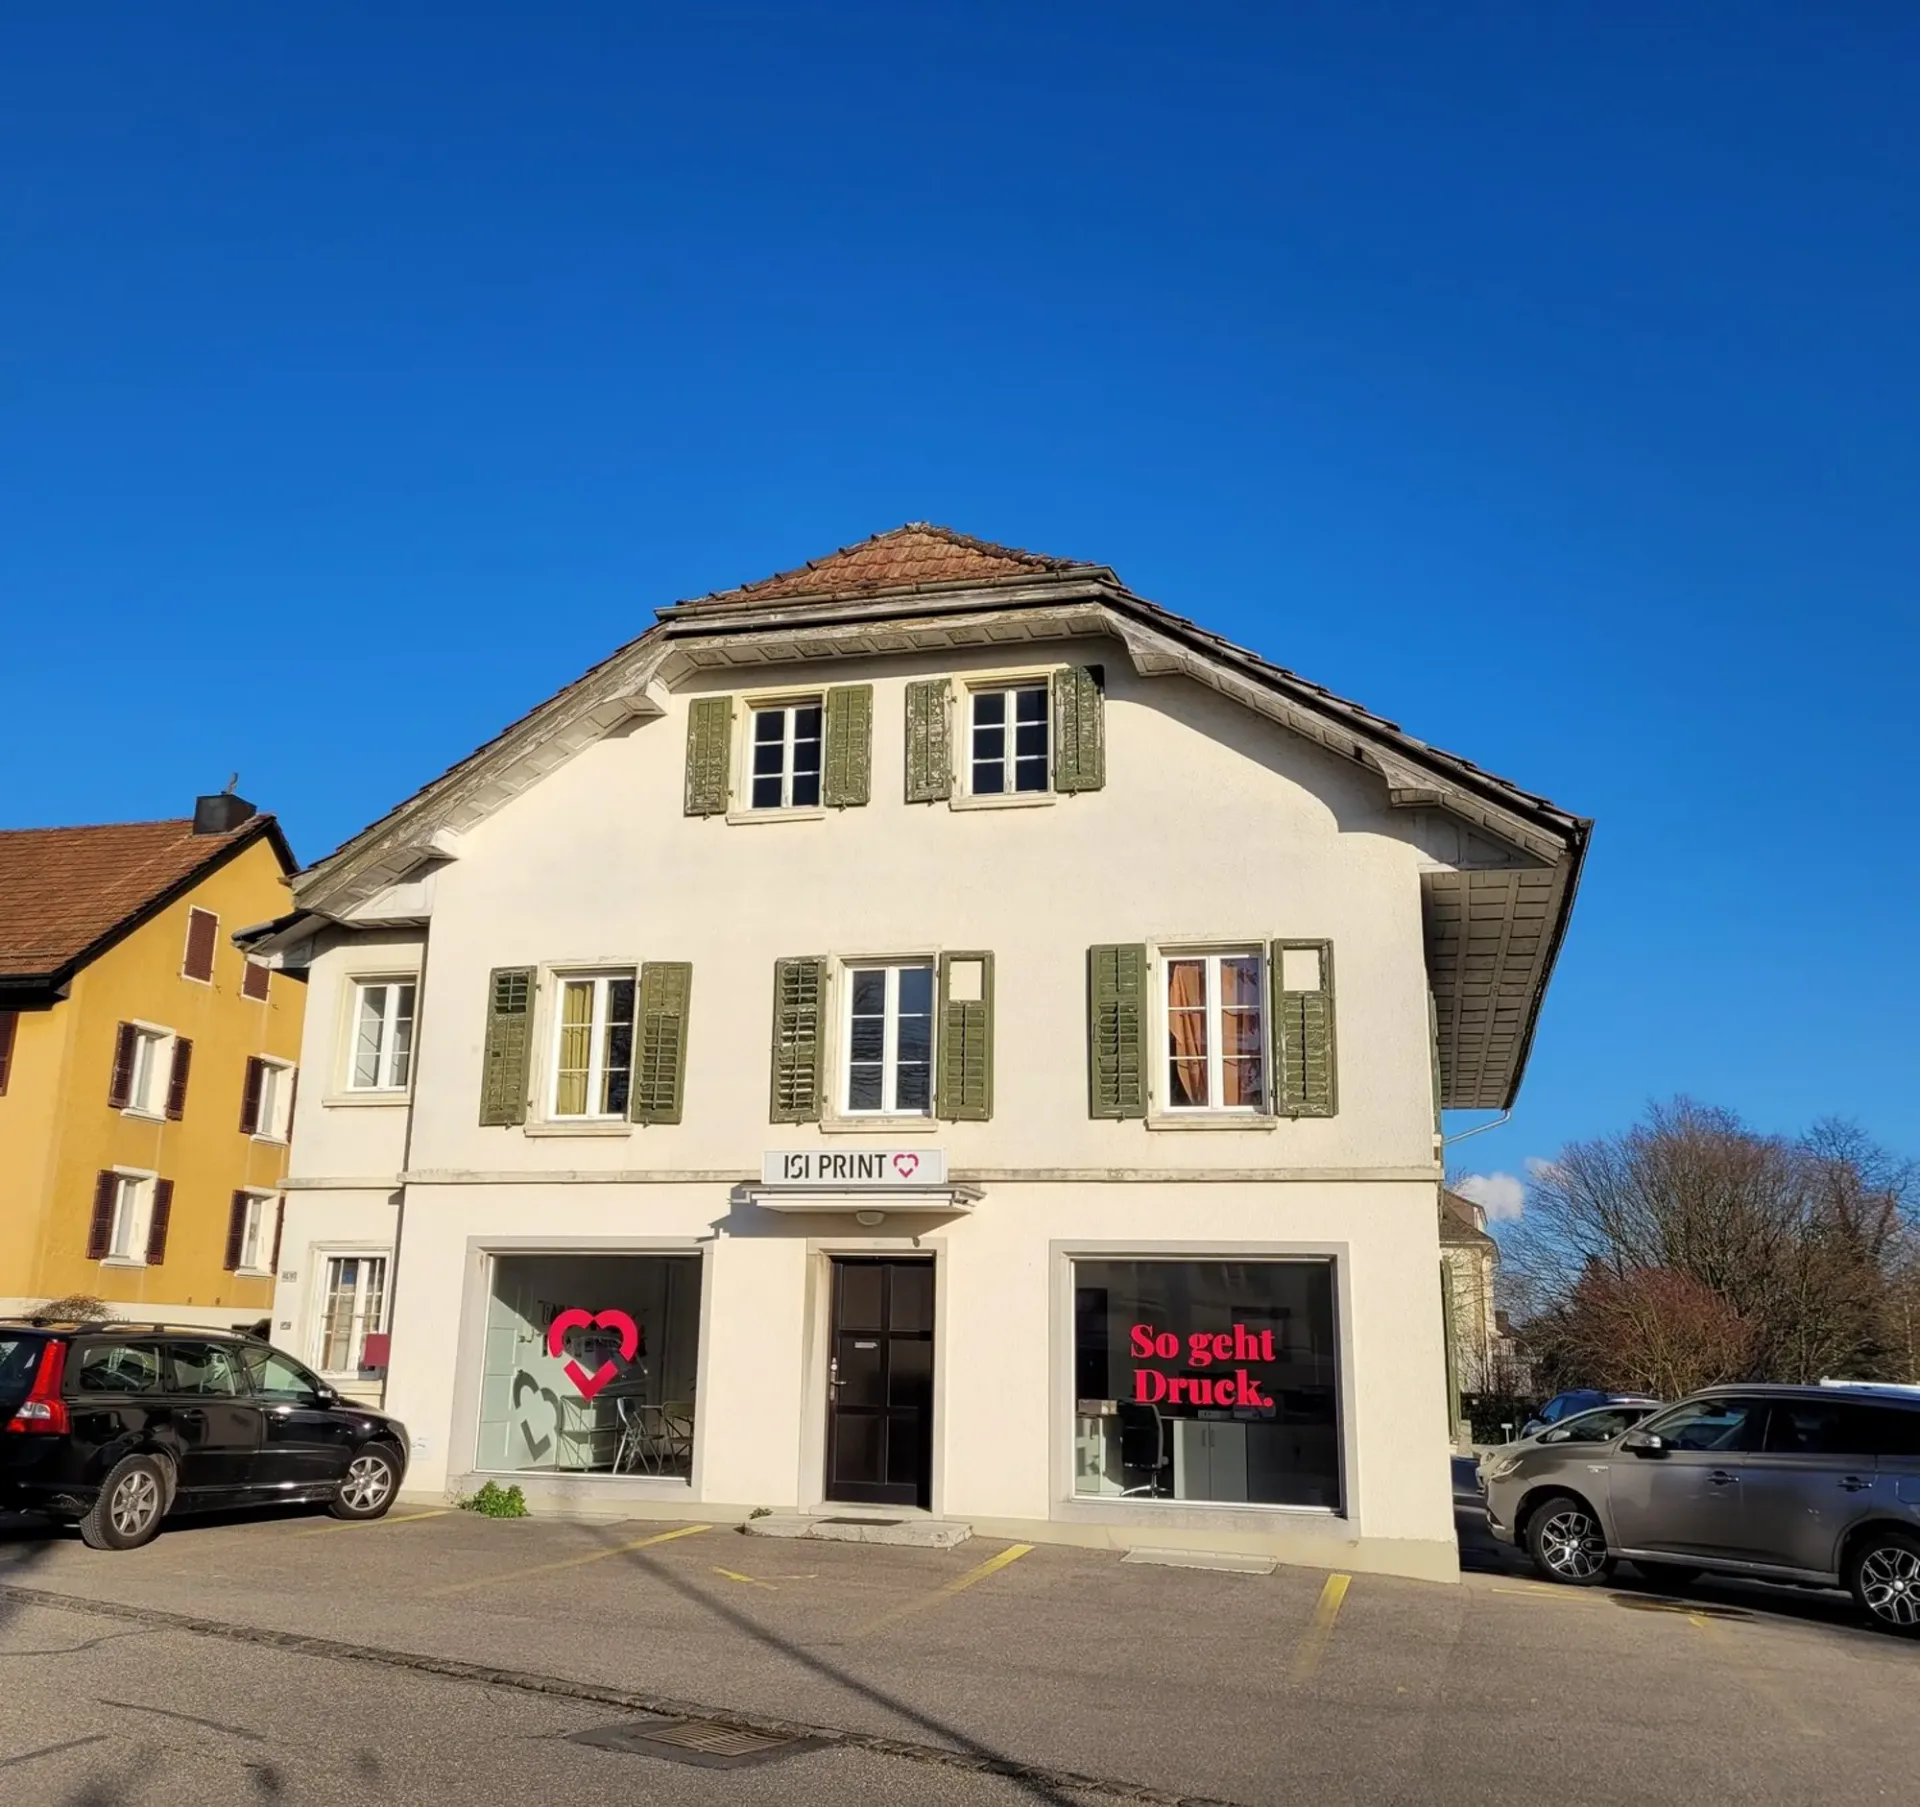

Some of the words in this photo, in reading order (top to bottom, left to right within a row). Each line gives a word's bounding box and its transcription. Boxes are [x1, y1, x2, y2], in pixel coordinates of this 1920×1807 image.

[784, 1154, 810, 1179] ISI
[818, 1154, 887, 1179] PRINT
[1130, 1324, 1179, 1359] So
[1188, 1324, 1276, 1367] geht
[1133, 1369, 1275, 1408] Druck.
